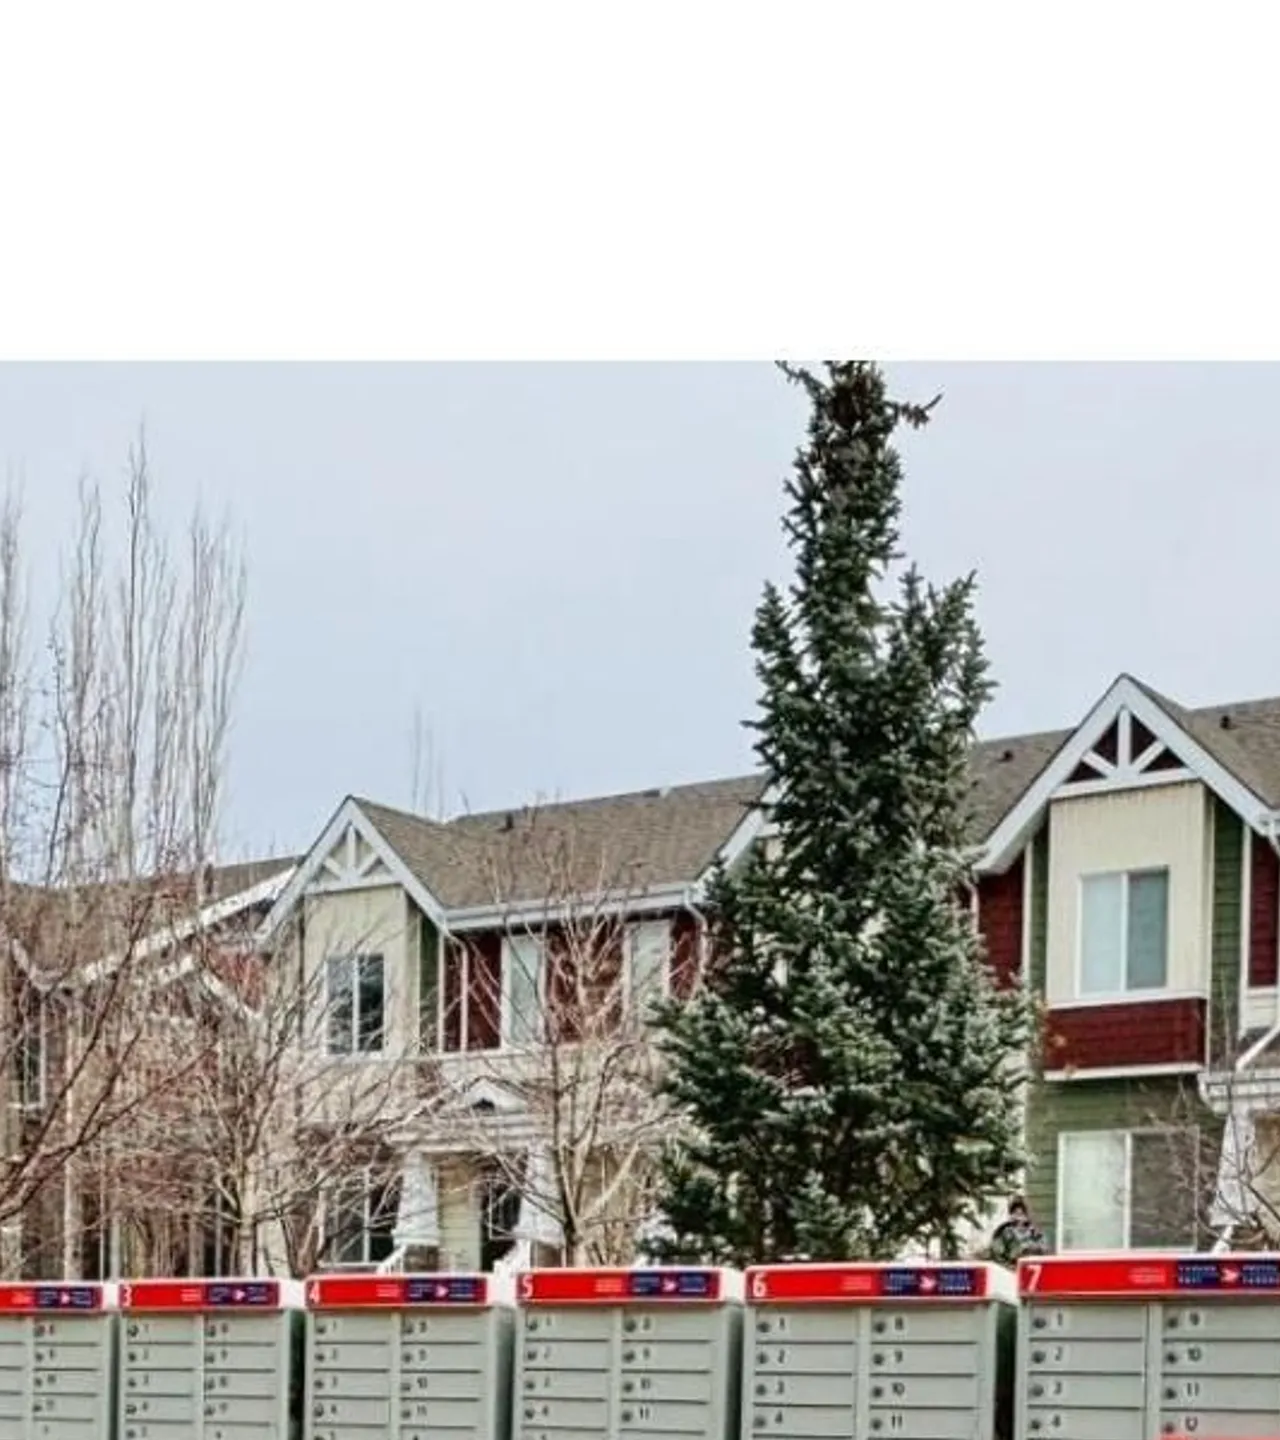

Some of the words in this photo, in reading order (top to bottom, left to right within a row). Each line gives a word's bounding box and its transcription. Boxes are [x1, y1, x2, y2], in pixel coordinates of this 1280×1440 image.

[752, 1272, 767, 1297] 6
[1025, 1264, 1042, 1292] 7
[1055, 1312, 1064, 1327] 1
[1054, 1345, 1064, 1362] 2
[1187, 1347, 1202, 1362] 10
[1186, 1382, 1200, 1397] 11
[1051, 1414, 1062, 1428] 4
